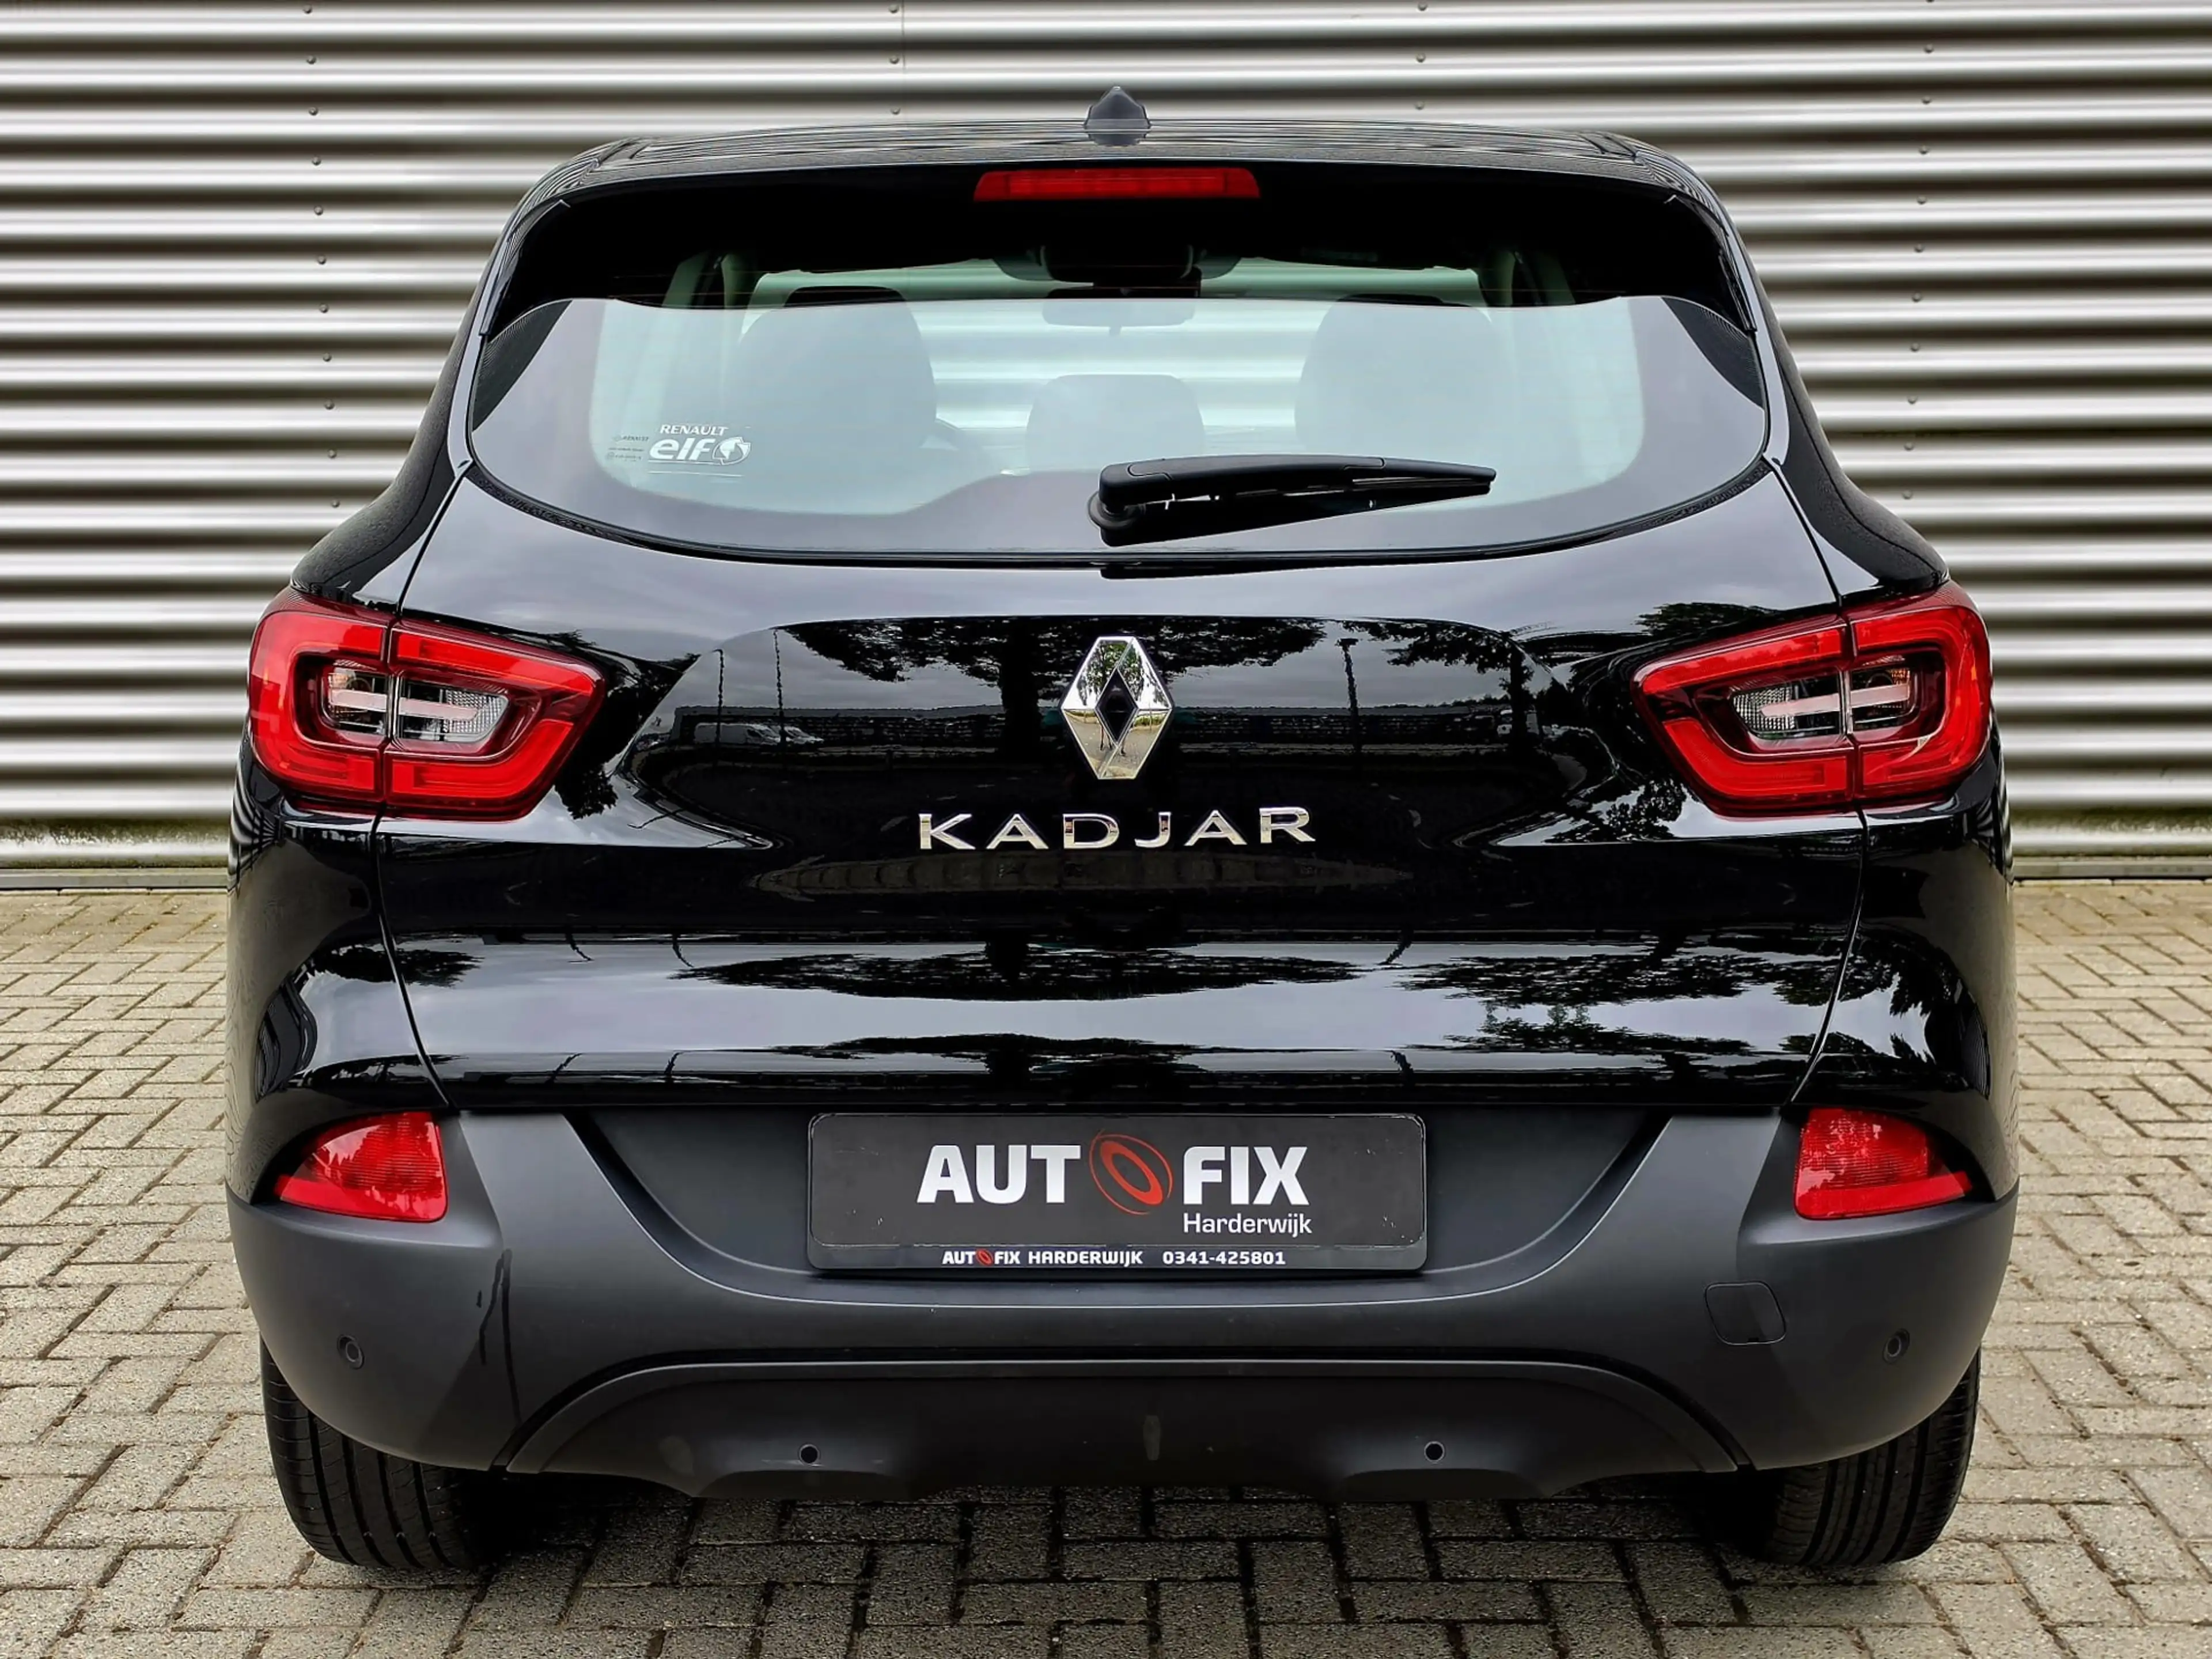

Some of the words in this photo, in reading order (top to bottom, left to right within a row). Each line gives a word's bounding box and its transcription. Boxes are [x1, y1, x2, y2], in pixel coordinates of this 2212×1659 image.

[659, 424, 729, 437] RENAULT
[649, 438, 716, 461] elf
[919, 807, 1316, 850] KADJAR
[1184, 1213, 1313, 1234] Harderwijk
[1027, 1250, 1143, 1266] HARDERWIJK
[1162, 1251, 1286, 1266] 0341-425801
